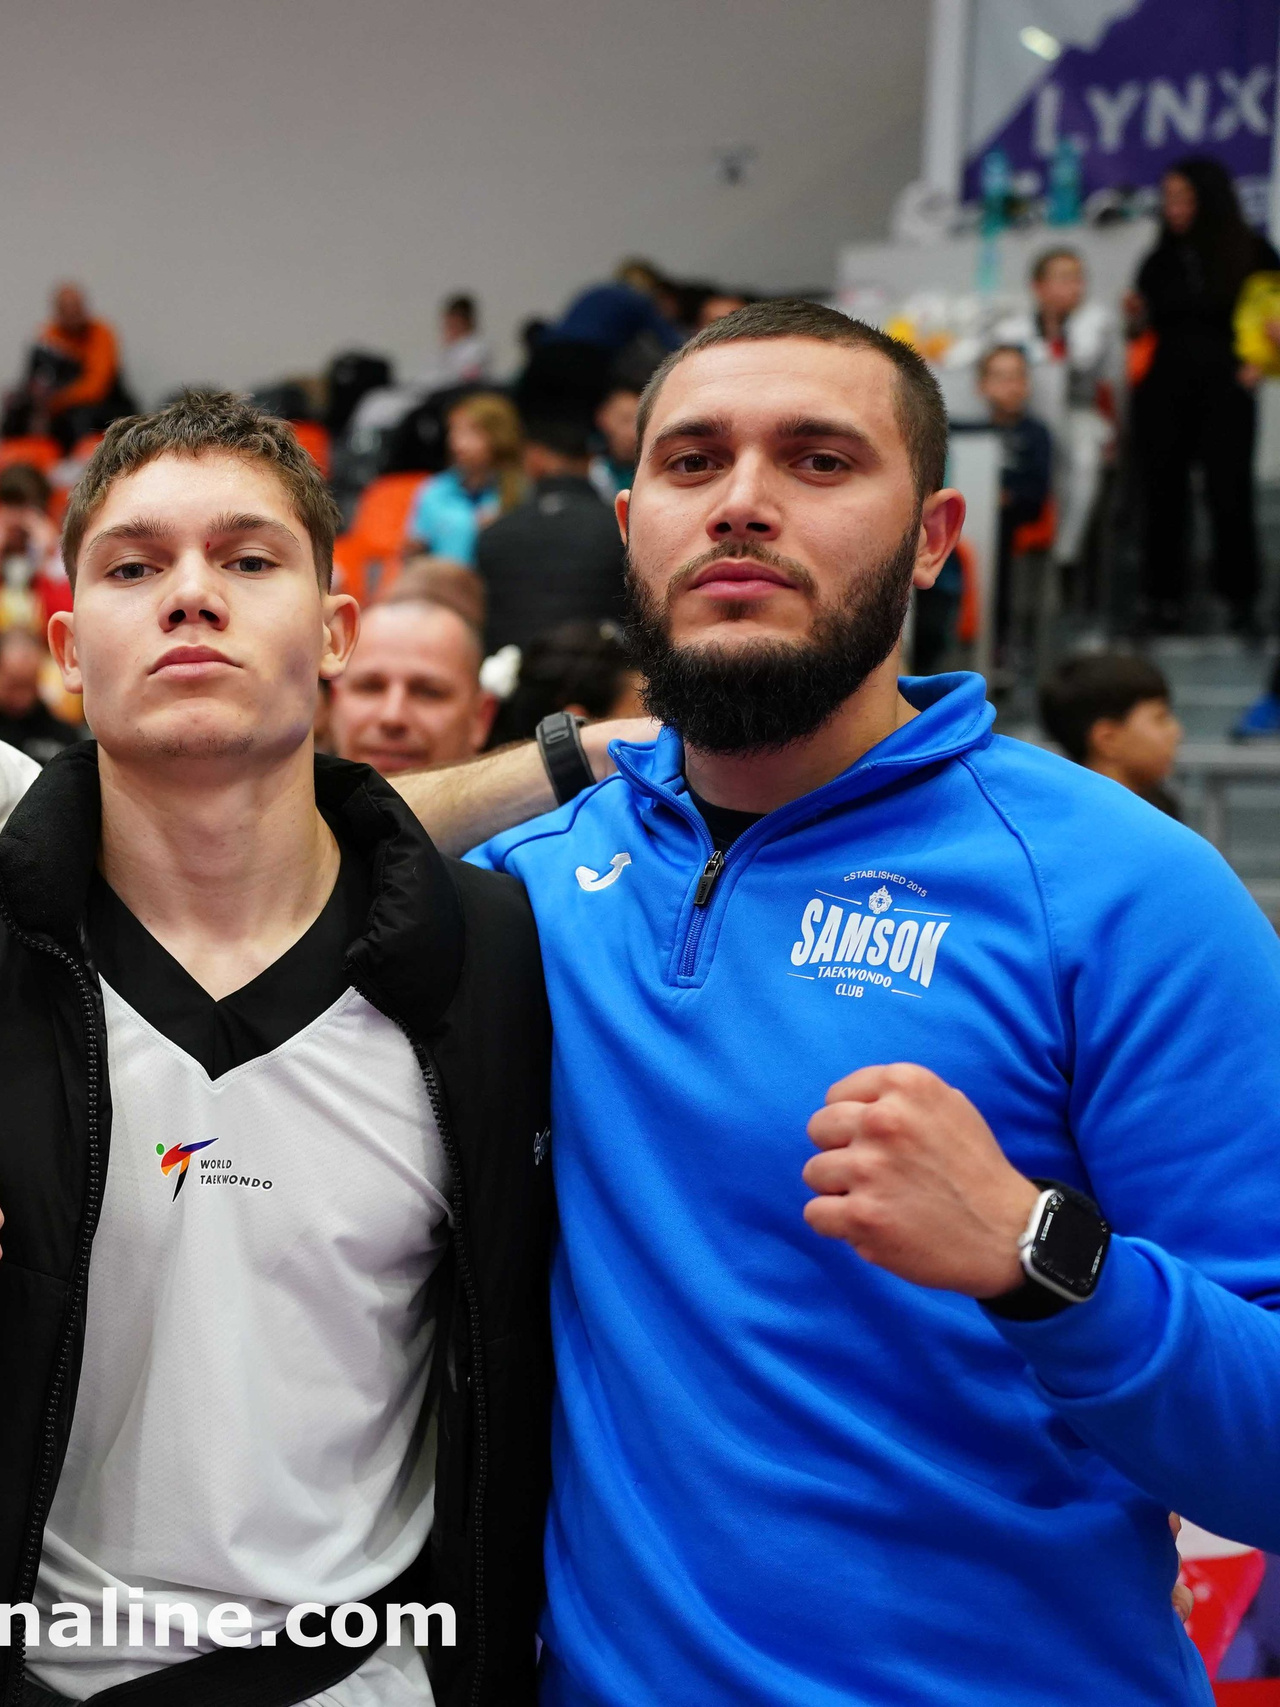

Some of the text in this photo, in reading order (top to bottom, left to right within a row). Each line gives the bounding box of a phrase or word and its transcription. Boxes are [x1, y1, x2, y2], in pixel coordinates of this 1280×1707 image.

[1034, 63, 1272, 158] LYNX
[843, 870, 928, 898] ESTABLISHED 2015
[790, 898, 951, 988] SAMSON
[817, 966, 892, 988] TAEKWONDO
[835, 983, 864, 998] CLUB
[200, 1159, 232, 1169] WORLD
[200, 1174, 273, 1190] TAEKWONDO
